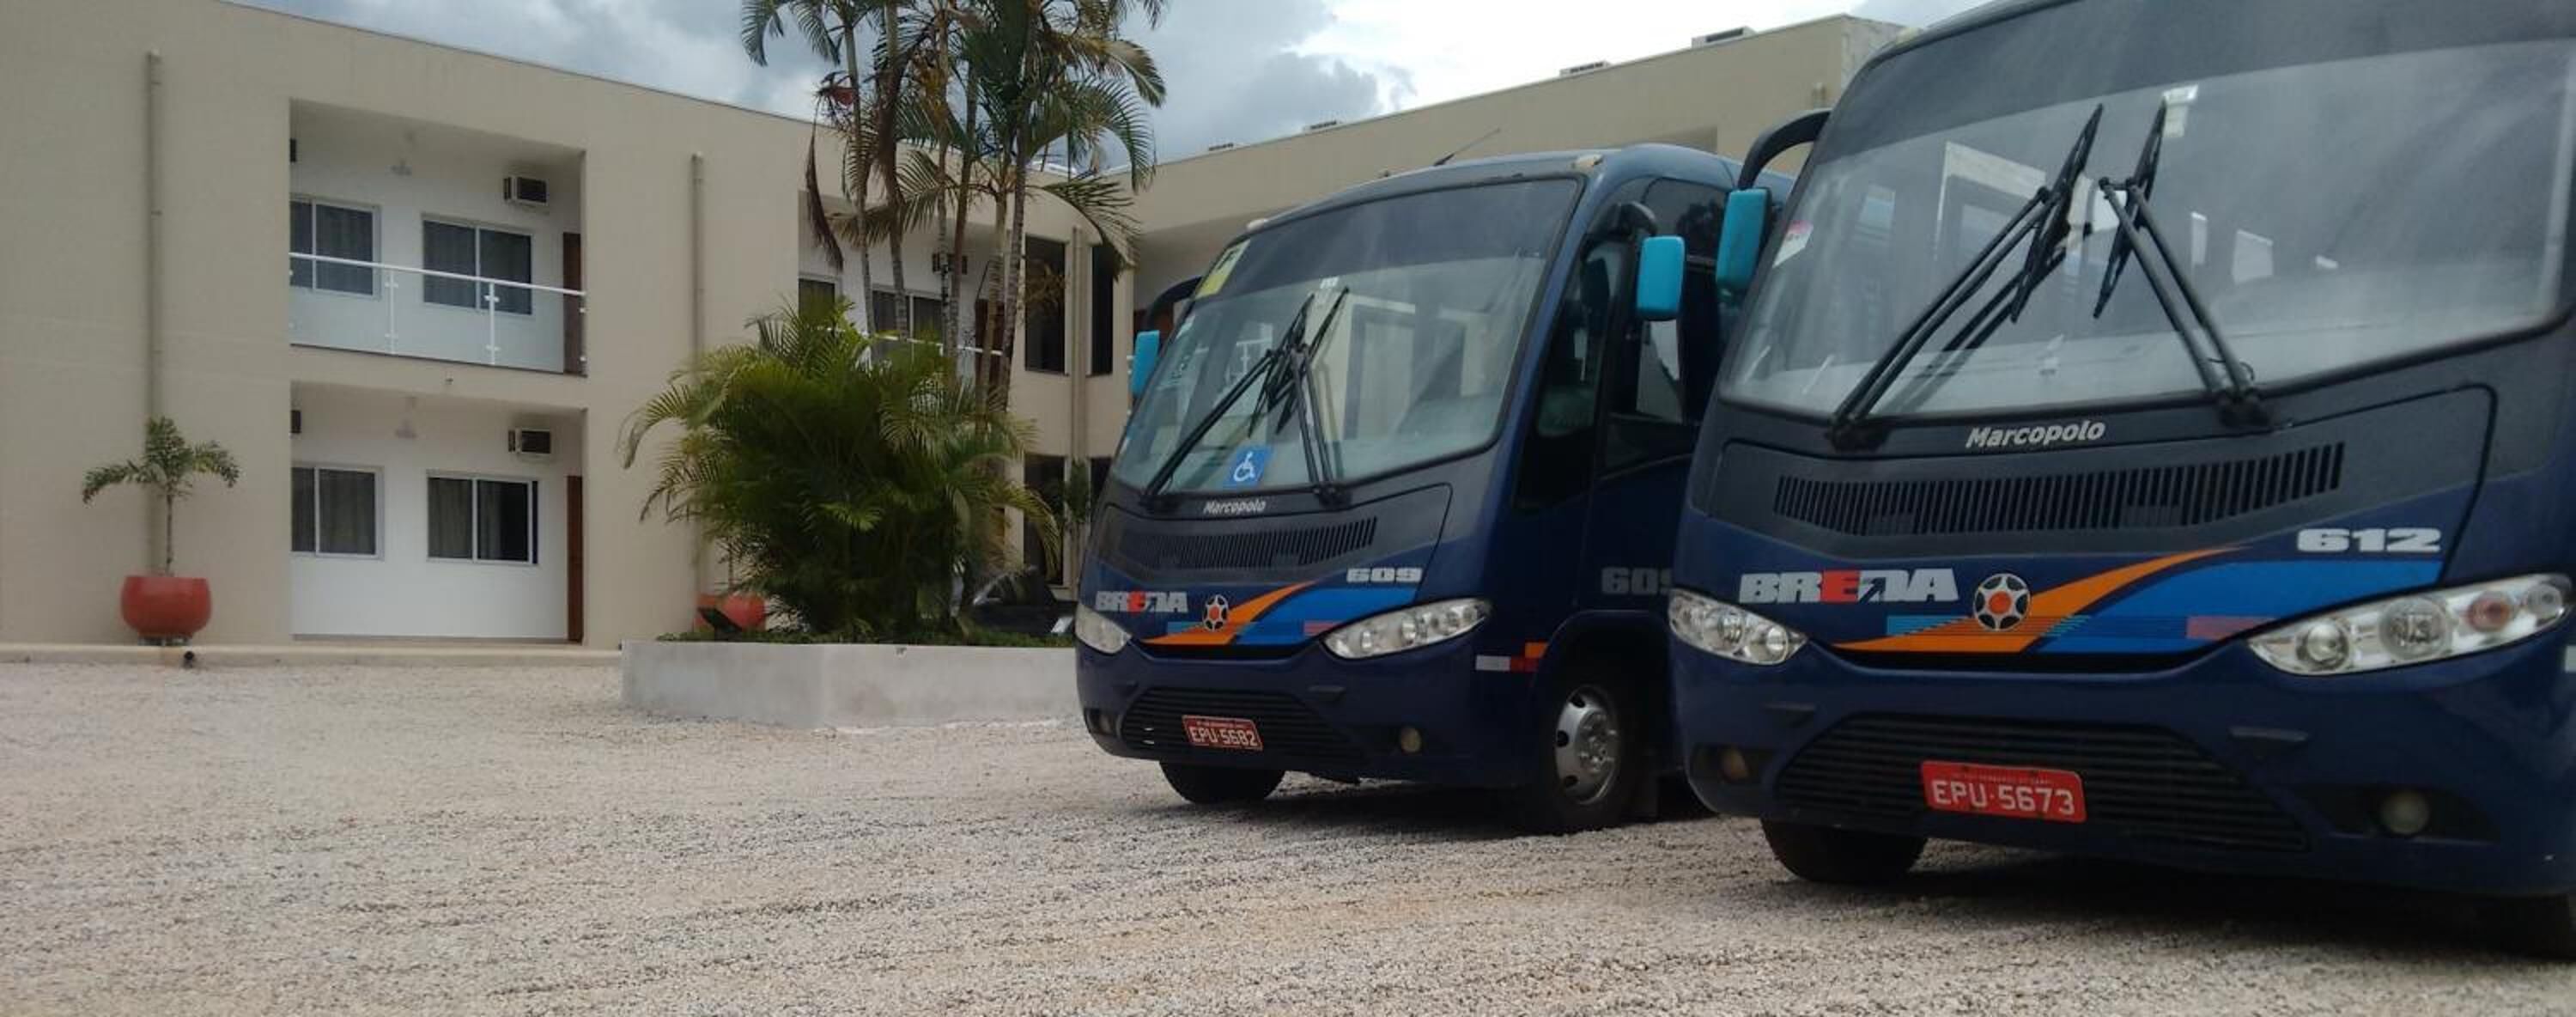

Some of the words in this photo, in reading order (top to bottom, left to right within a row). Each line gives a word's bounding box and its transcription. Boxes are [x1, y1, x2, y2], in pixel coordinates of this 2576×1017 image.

[1965, 420, 2105, 448] Marcopolo
[1203, 498, 1267, 515] Marcopolo
[2297, 527, 2441, 552] 612
[1346, 567, 1423, 583] 609
[1739, 568, 1959, 604] BREDA
